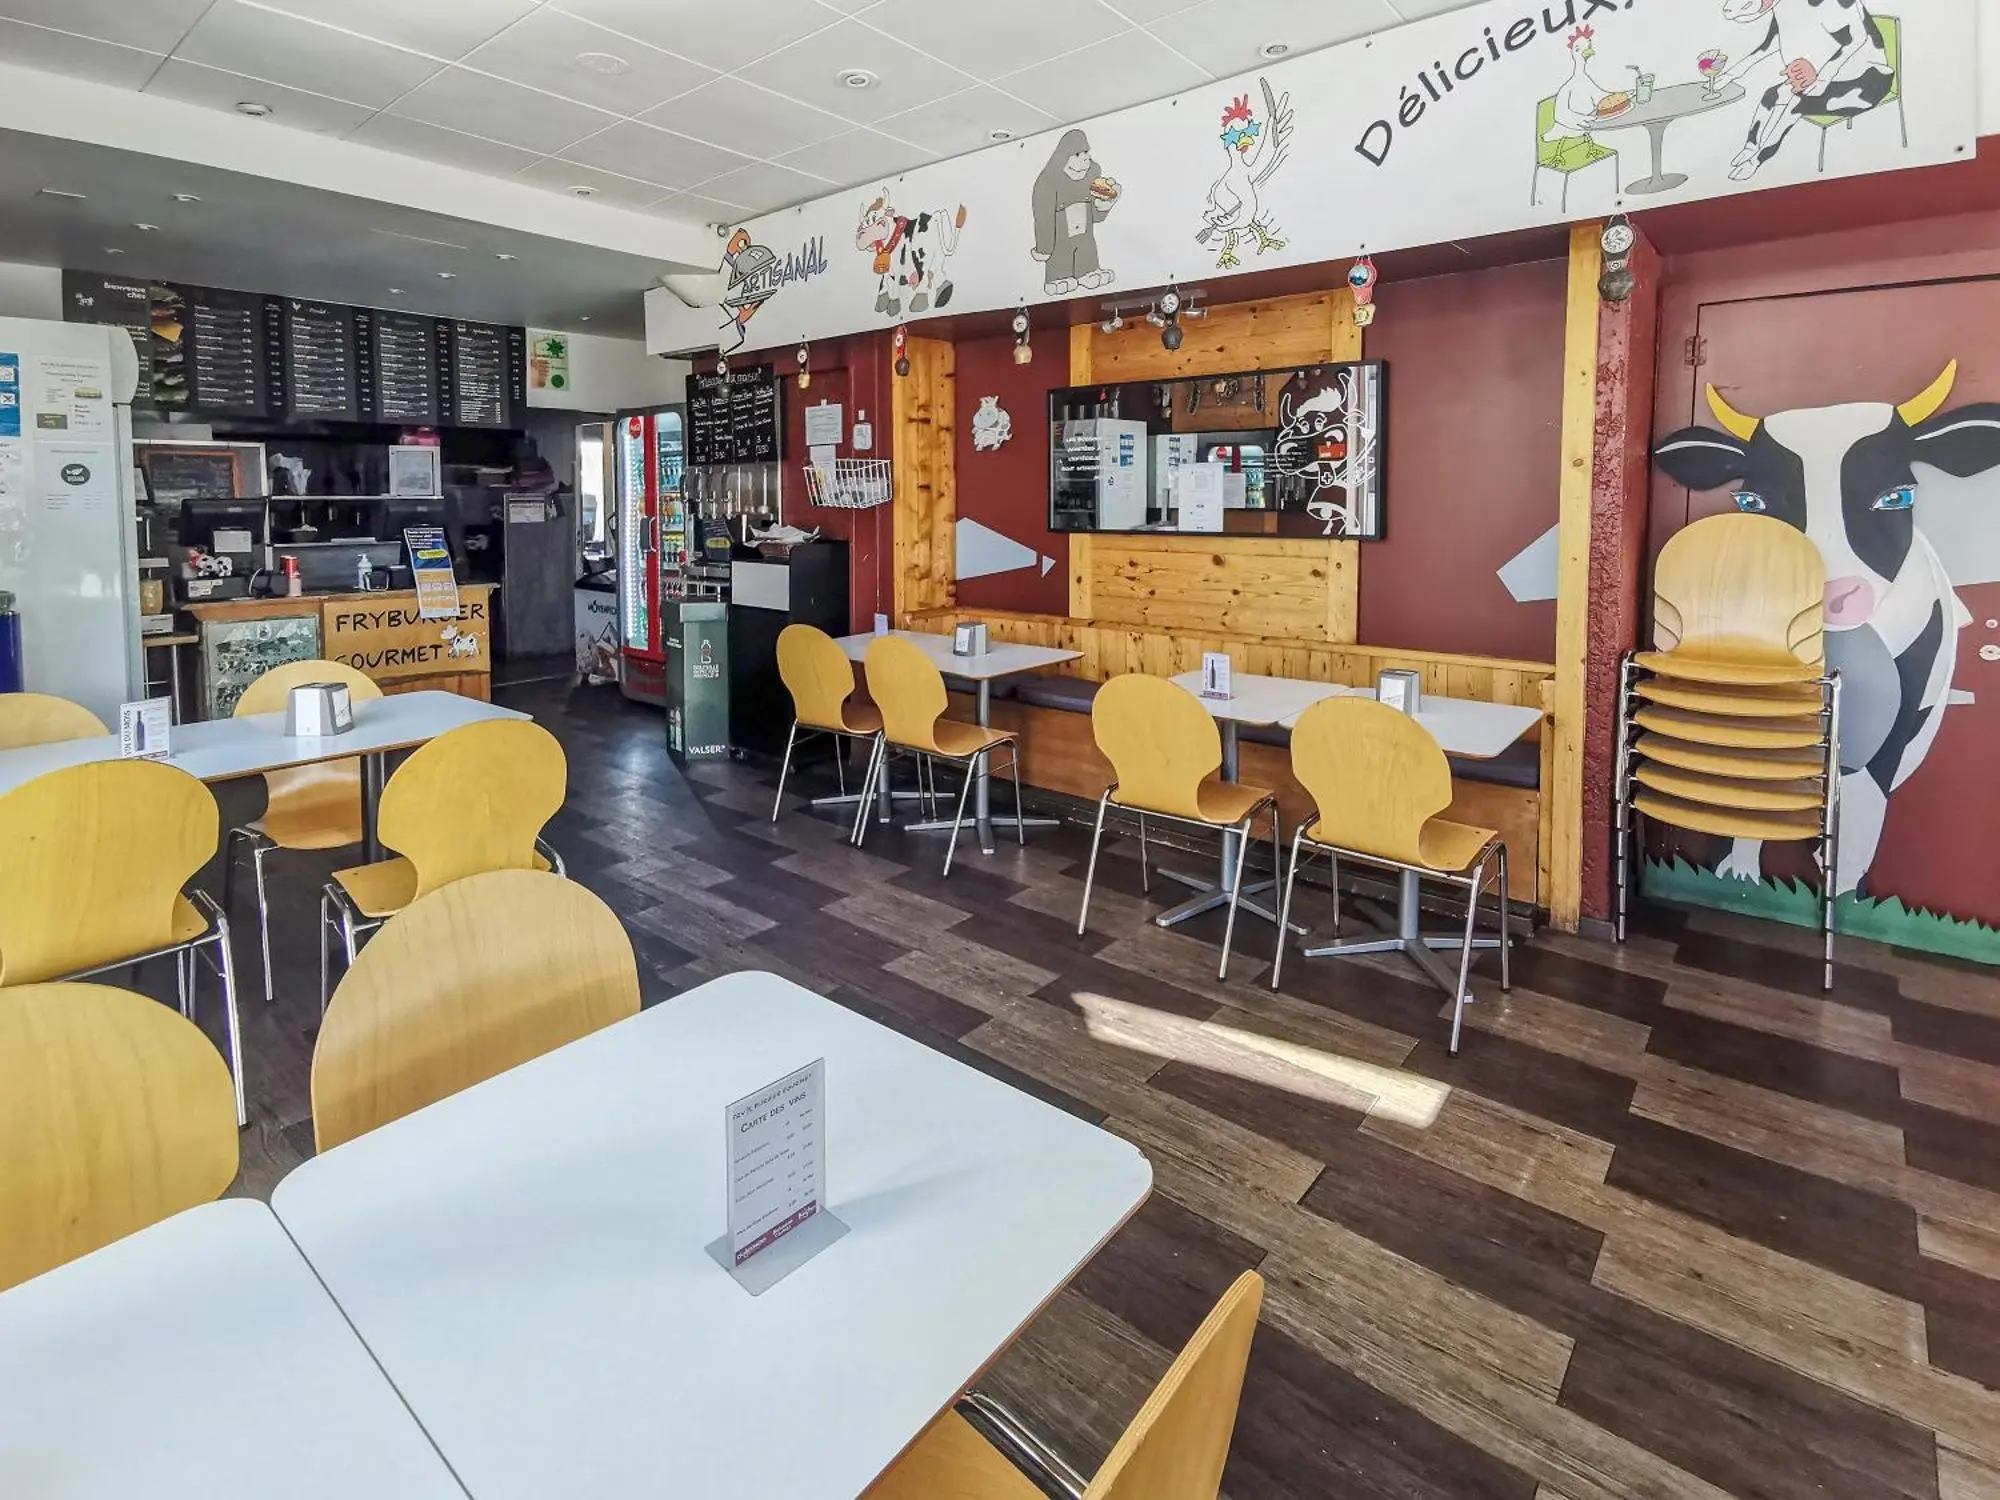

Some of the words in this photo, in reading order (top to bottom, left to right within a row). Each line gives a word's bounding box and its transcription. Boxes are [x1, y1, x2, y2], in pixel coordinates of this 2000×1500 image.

[741, 235, 829, 298] ARTISANAL
[336, 603, 485, 632] FRYBUER
[741, 1113, 767, 1132] CARTE
[770, 1103, 785, 1117] DES
[788, 1091, 807, 1106] VINS
